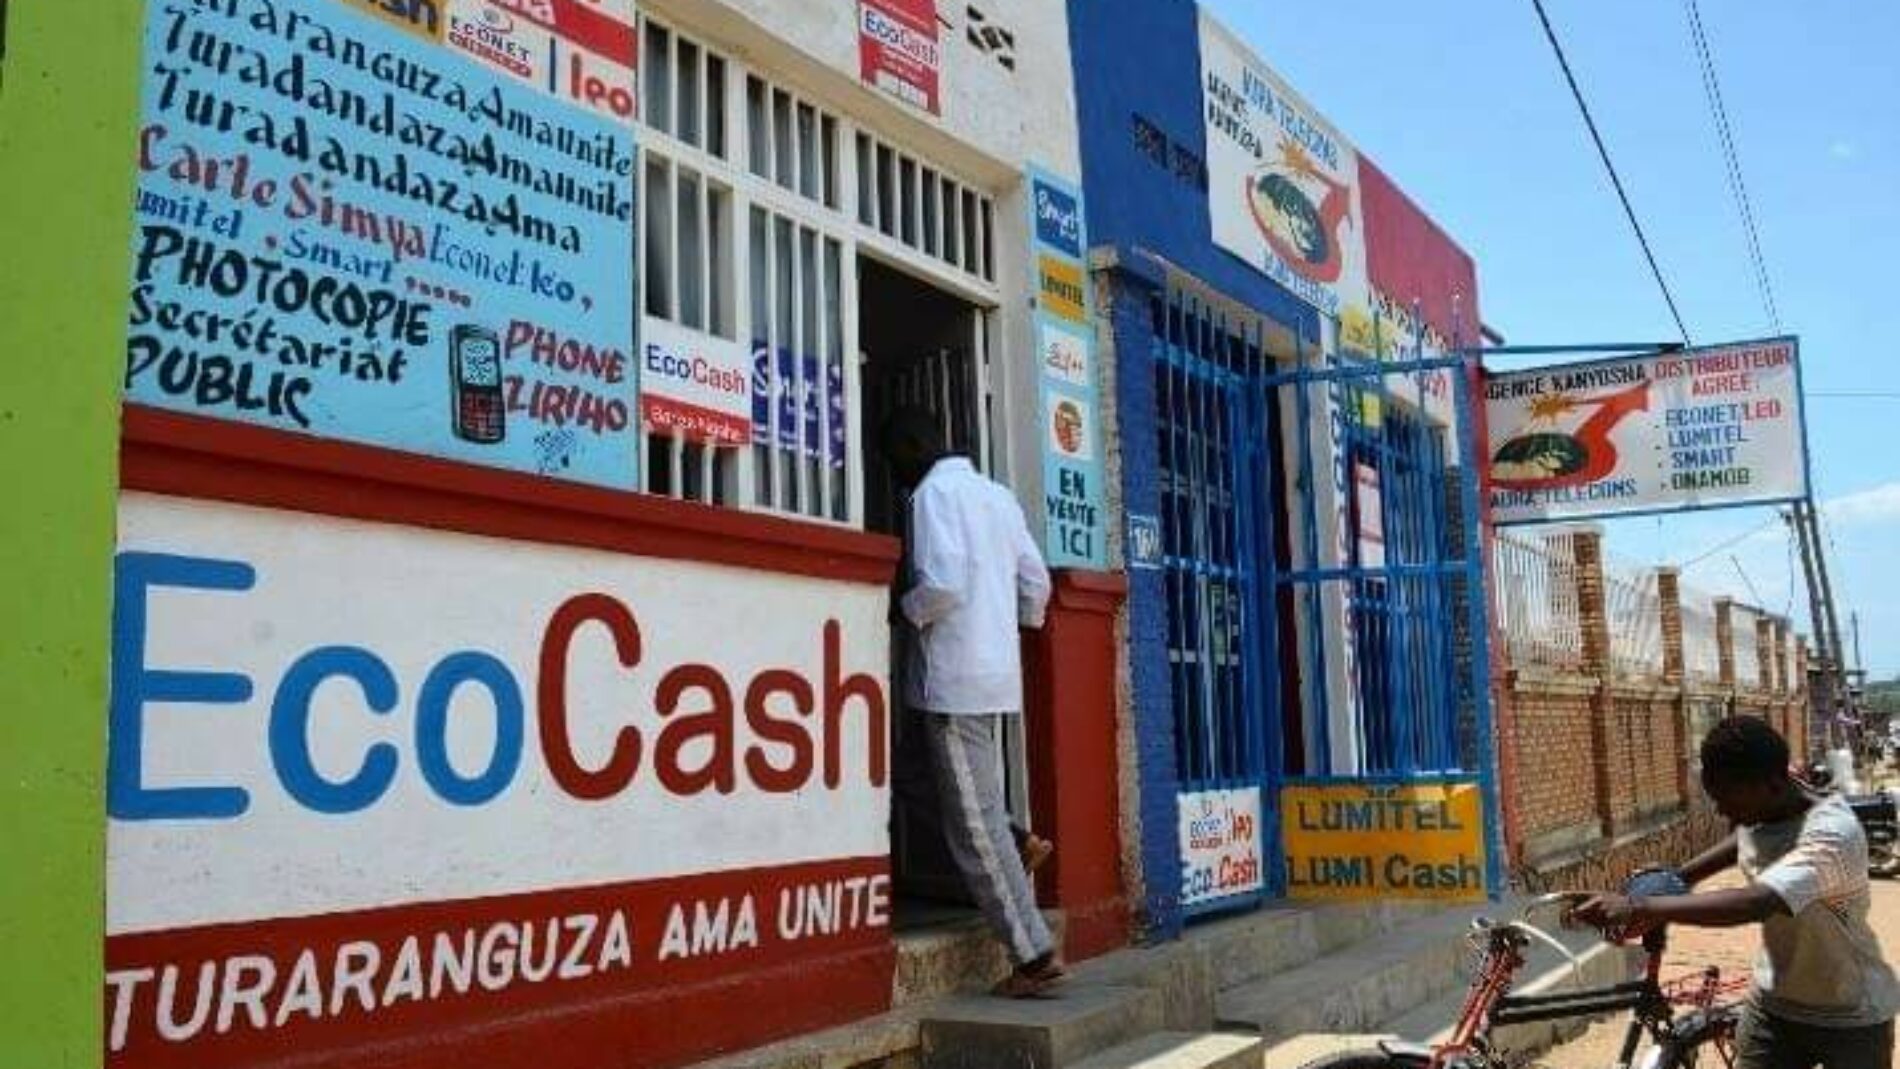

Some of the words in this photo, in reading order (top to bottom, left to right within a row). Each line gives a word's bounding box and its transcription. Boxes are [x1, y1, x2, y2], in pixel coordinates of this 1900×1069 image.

[865, 9, 939, 66] EcoCash
[570, 53, 634, 116] leo
[136, 226, 431, 346] PHOTOCOPIE
[130, 285, 407, 383] Secrétariat
[505, 320, 626, 383] PHONE
[126, 335, 312, 427] PUBLIC
[646, 343, 745, 394] EcoCash
[1655, 347, 1790, 378] DISTRIBUTEUR
[1666, 403, 1738, 427] ECONET
[1668, 424, 1751, 447] LUMITEL
[1671, 446, 1736, 469] SMART
[1059, 467, 1086, 499] EN
[1046, 496, 1098, 528] VENTE
[1059, 526, 1093, 560] ICI
[107, 551, 887, 820] EcoCash
[1297, 800, 1464, 831] LUMITEL
[1219, 849, 1258, 888] Cash
[1286, 854, 1375, 887] LUMI
[1384, 853, 1481, 890] Cash
[105, 911, 631, 1051] TURARANGUZA
[657, 893, 758, 962] AMA
[777, 874, 889, 941] UNITE
